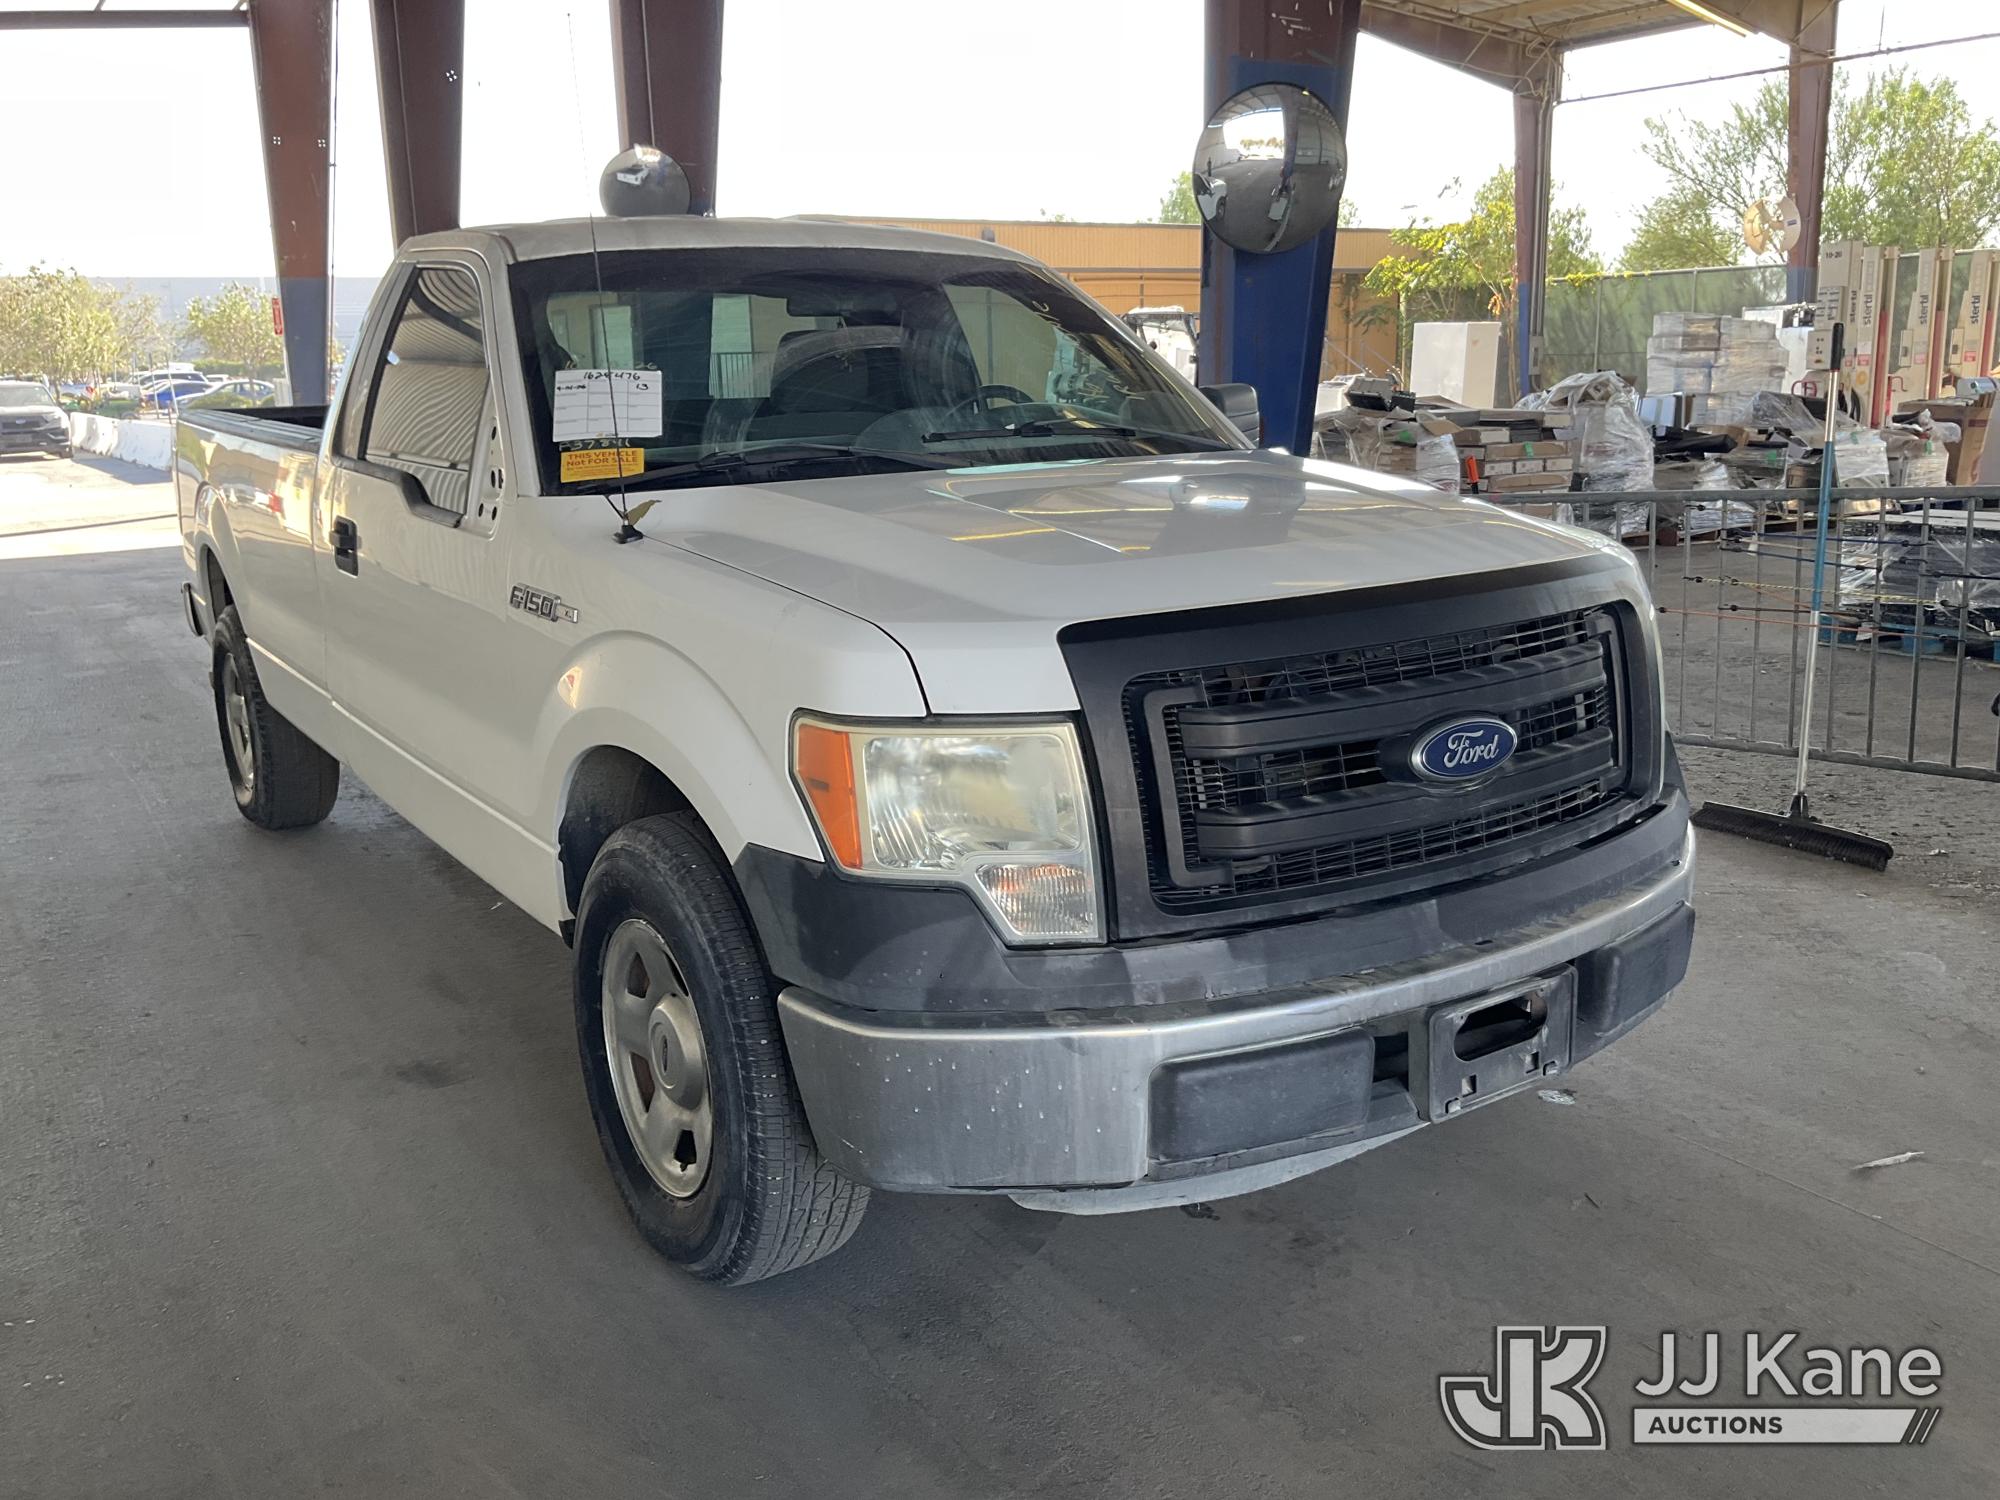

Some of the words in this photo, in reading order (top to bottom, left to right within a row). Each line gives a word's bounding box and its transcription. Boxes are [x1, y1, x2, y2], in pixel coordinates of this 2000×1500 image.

[1863, 294, 1873, 326] stertil
[1919, 294, 1929, 325] stertil
[1970, 294, 1981, 324] stertil
[567, 452, 593, 460] THIS
[594, 449, 639, 459] VEHCLE
[587, 457, 609, 465] FOR
[611, 456, 639, 464] SALE
[1443, 729, 1500, 768] Ford
